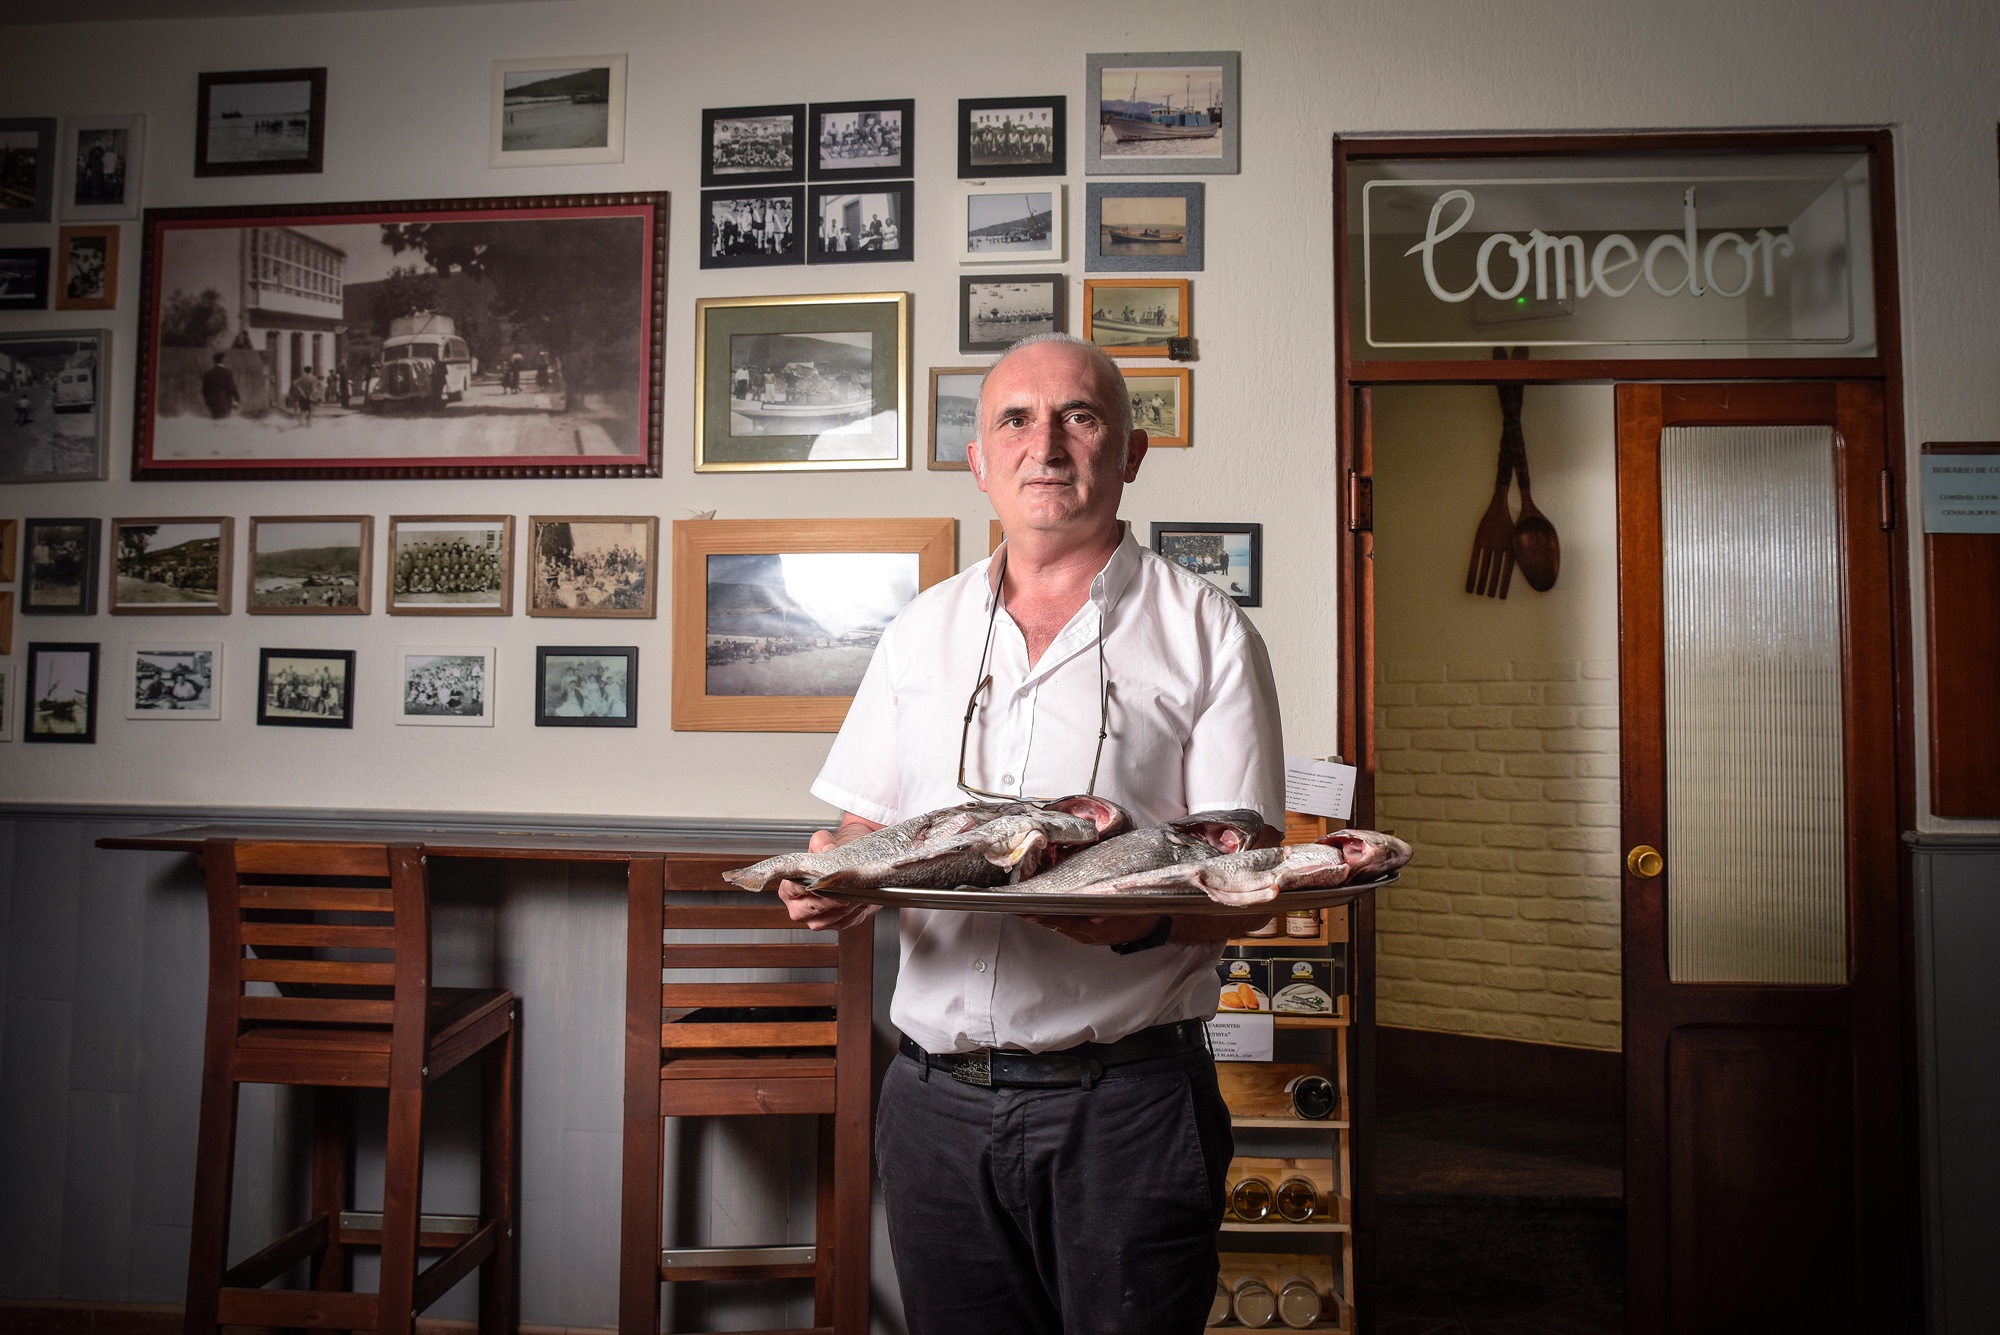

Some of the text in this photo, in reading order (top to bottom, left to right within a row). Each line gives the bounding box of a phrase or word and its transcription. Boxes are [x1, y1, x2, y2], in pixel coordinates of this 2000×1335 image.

[1404, 186, 1794, 302] Comedor
[1932, 466, 1974, 474] HORARIO
[1975, 466, 1987, 474] DE
